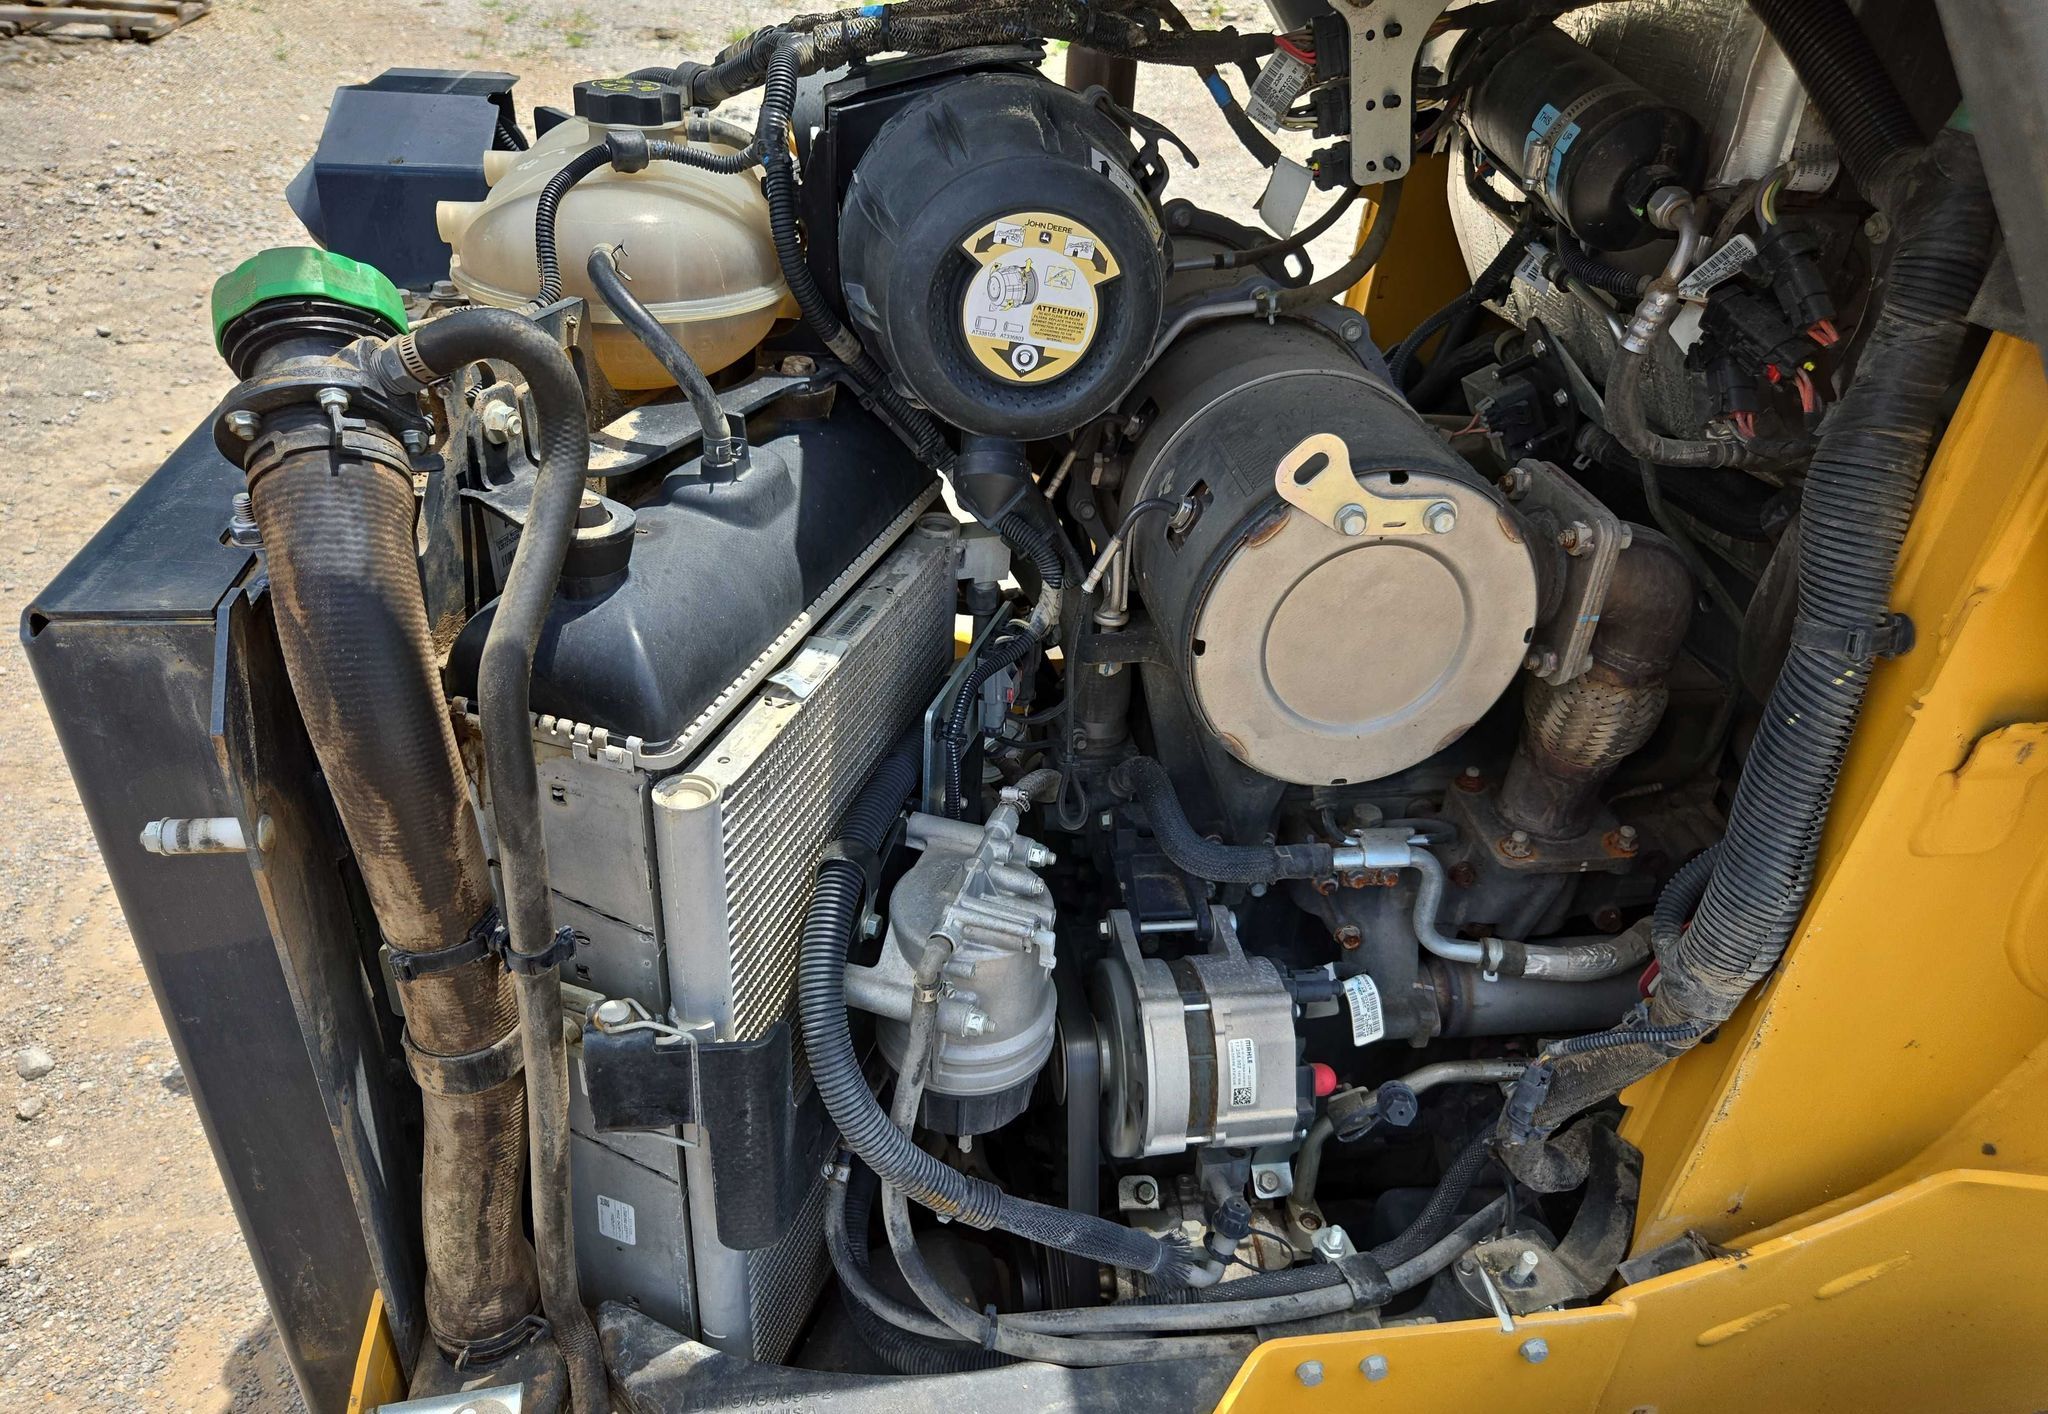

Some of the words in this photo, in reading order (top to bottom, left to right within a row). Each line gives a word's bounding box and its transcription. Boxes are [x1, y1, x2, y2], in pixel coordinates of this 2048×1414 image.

[1278, 75, 1293, 94] MEXICO
[1025, 219, 1046, 229] JOHN
[1047, 222, 1073, 234] DEERE
[1037, 305, 1085, 318] ATTENTION!
